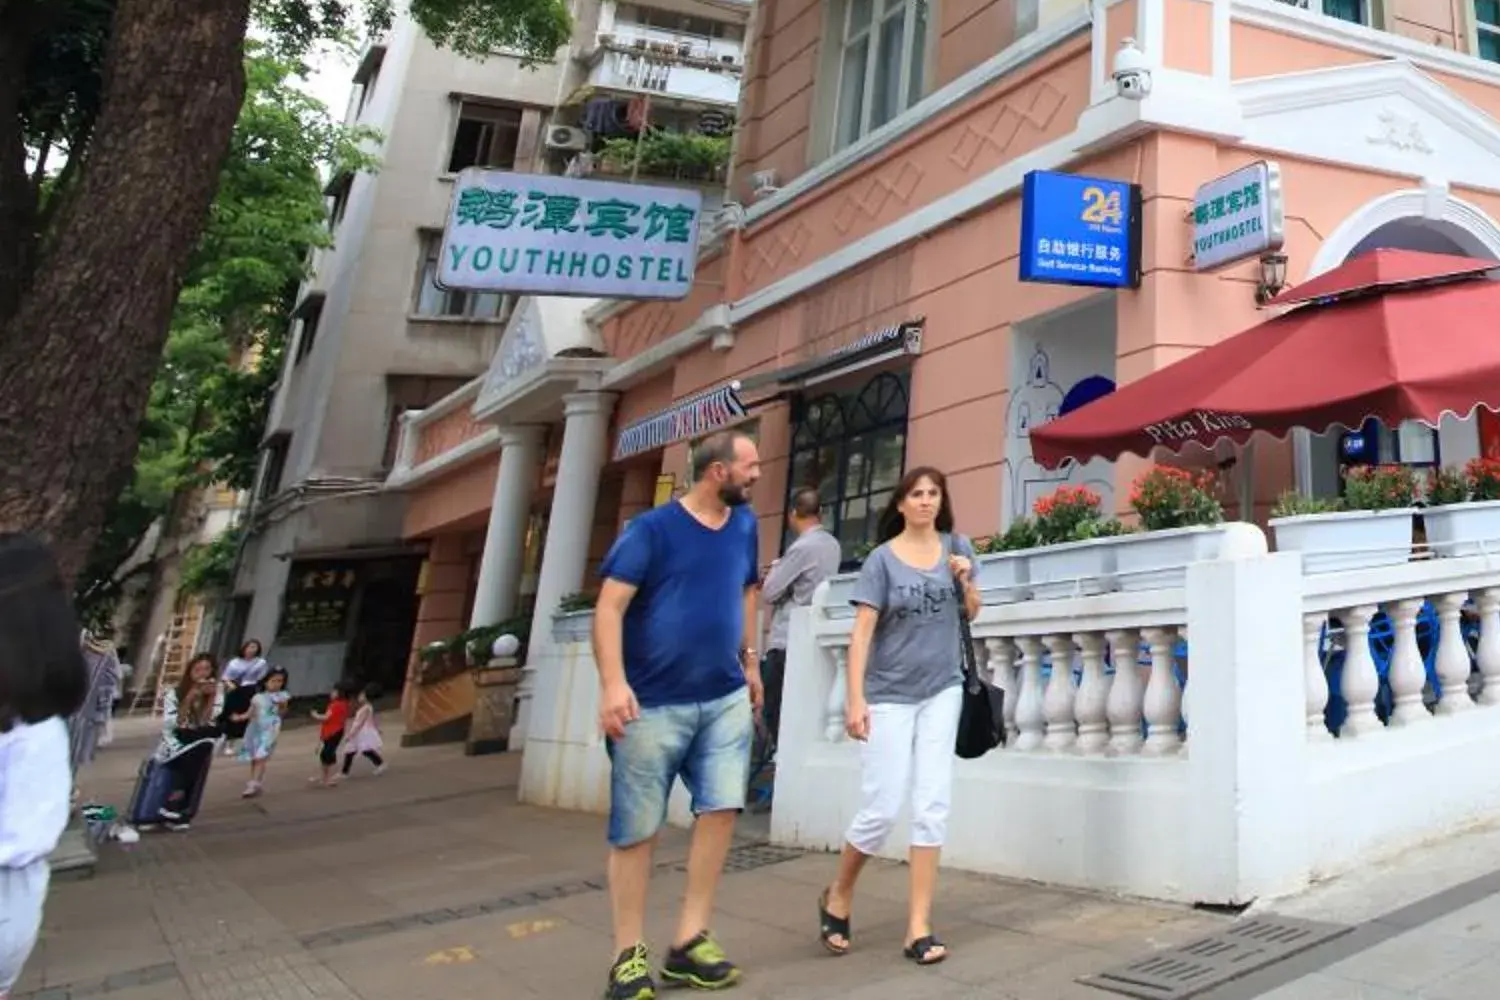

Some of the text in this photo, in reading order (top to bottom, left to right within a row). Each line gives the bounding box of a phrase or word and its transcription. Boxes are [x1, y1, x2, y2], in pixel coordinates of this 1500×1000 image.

[1081, 186, 1122, 225] 24
[1037, 239, 1121, 261] 自助银行服务
[1143, 410, 1252, 443] Pita King
